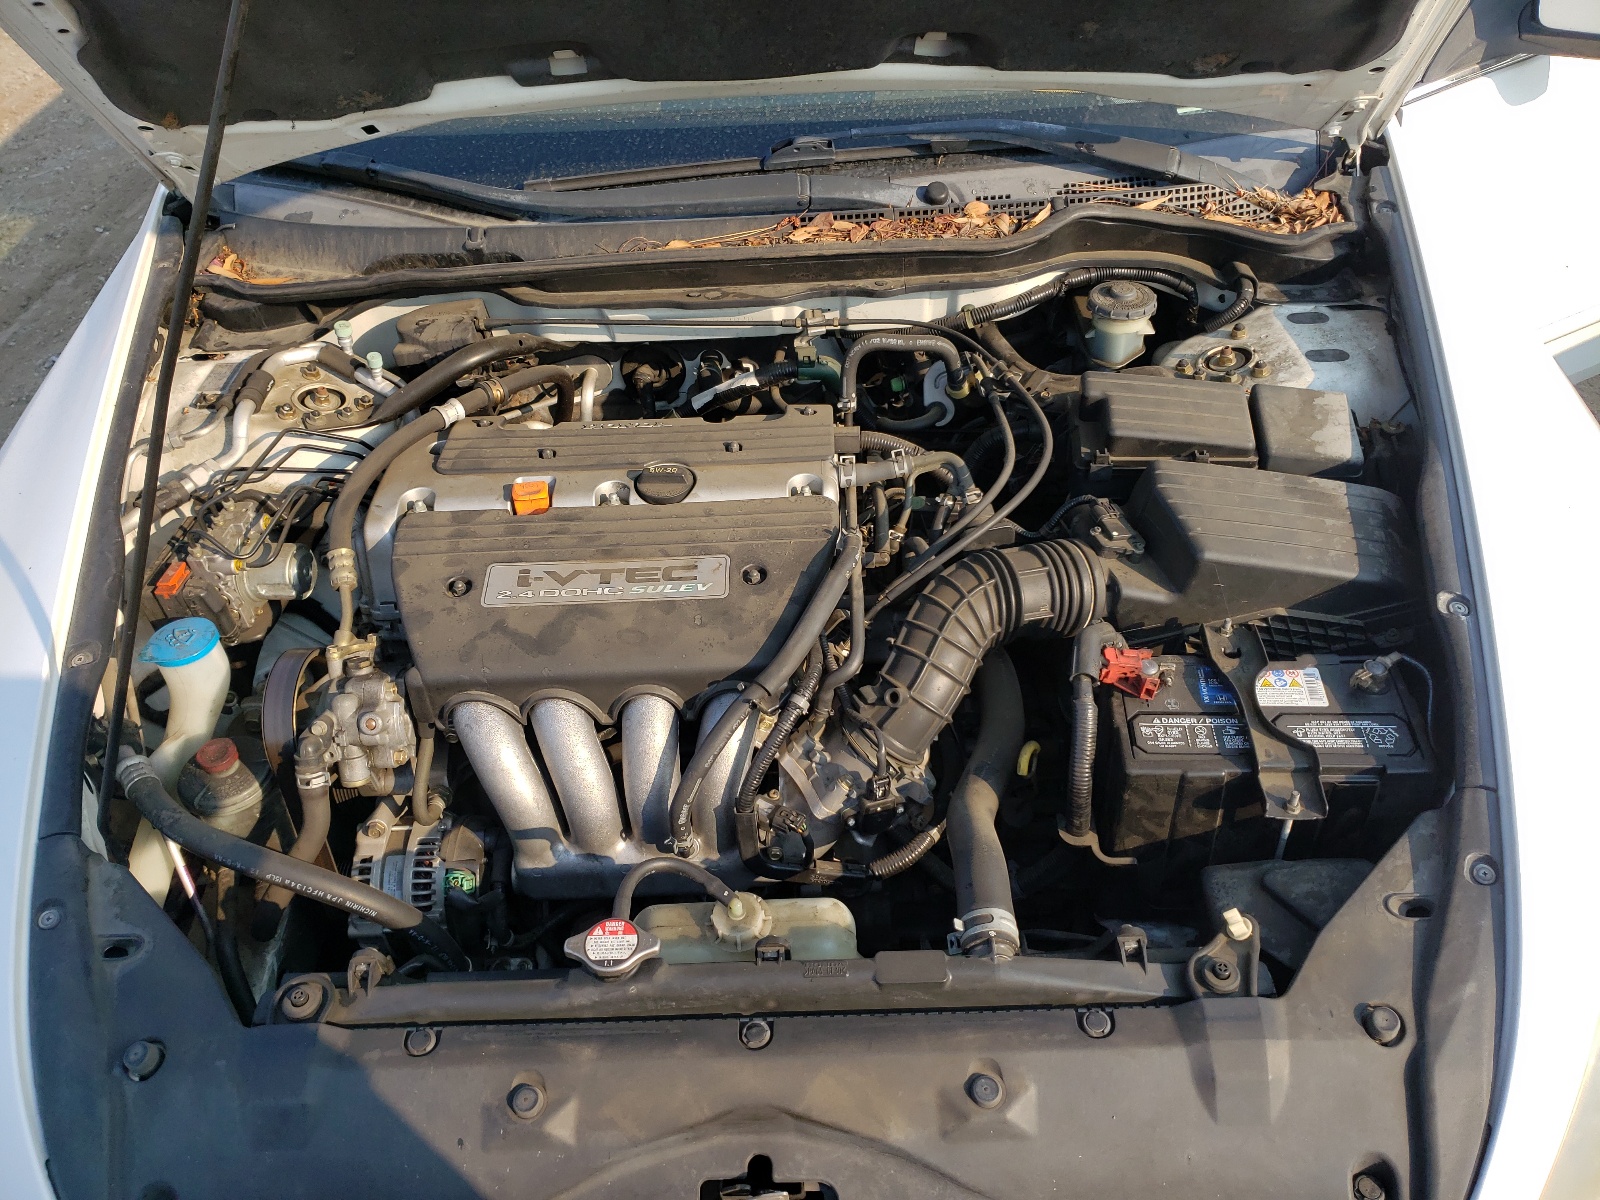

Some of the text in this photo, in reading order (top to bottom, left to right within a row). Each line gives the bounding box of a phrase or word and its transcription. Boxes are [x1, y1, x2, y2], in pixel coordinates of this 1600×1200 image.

[517, 564, 698, 588] i-VTEC
[539, 586, 624, 597] DOHC
[629, 582, 714, 595] SULEV
[326, 893, 343, 904] JPN
[345, 900, 378, 917] NICHIRIN
